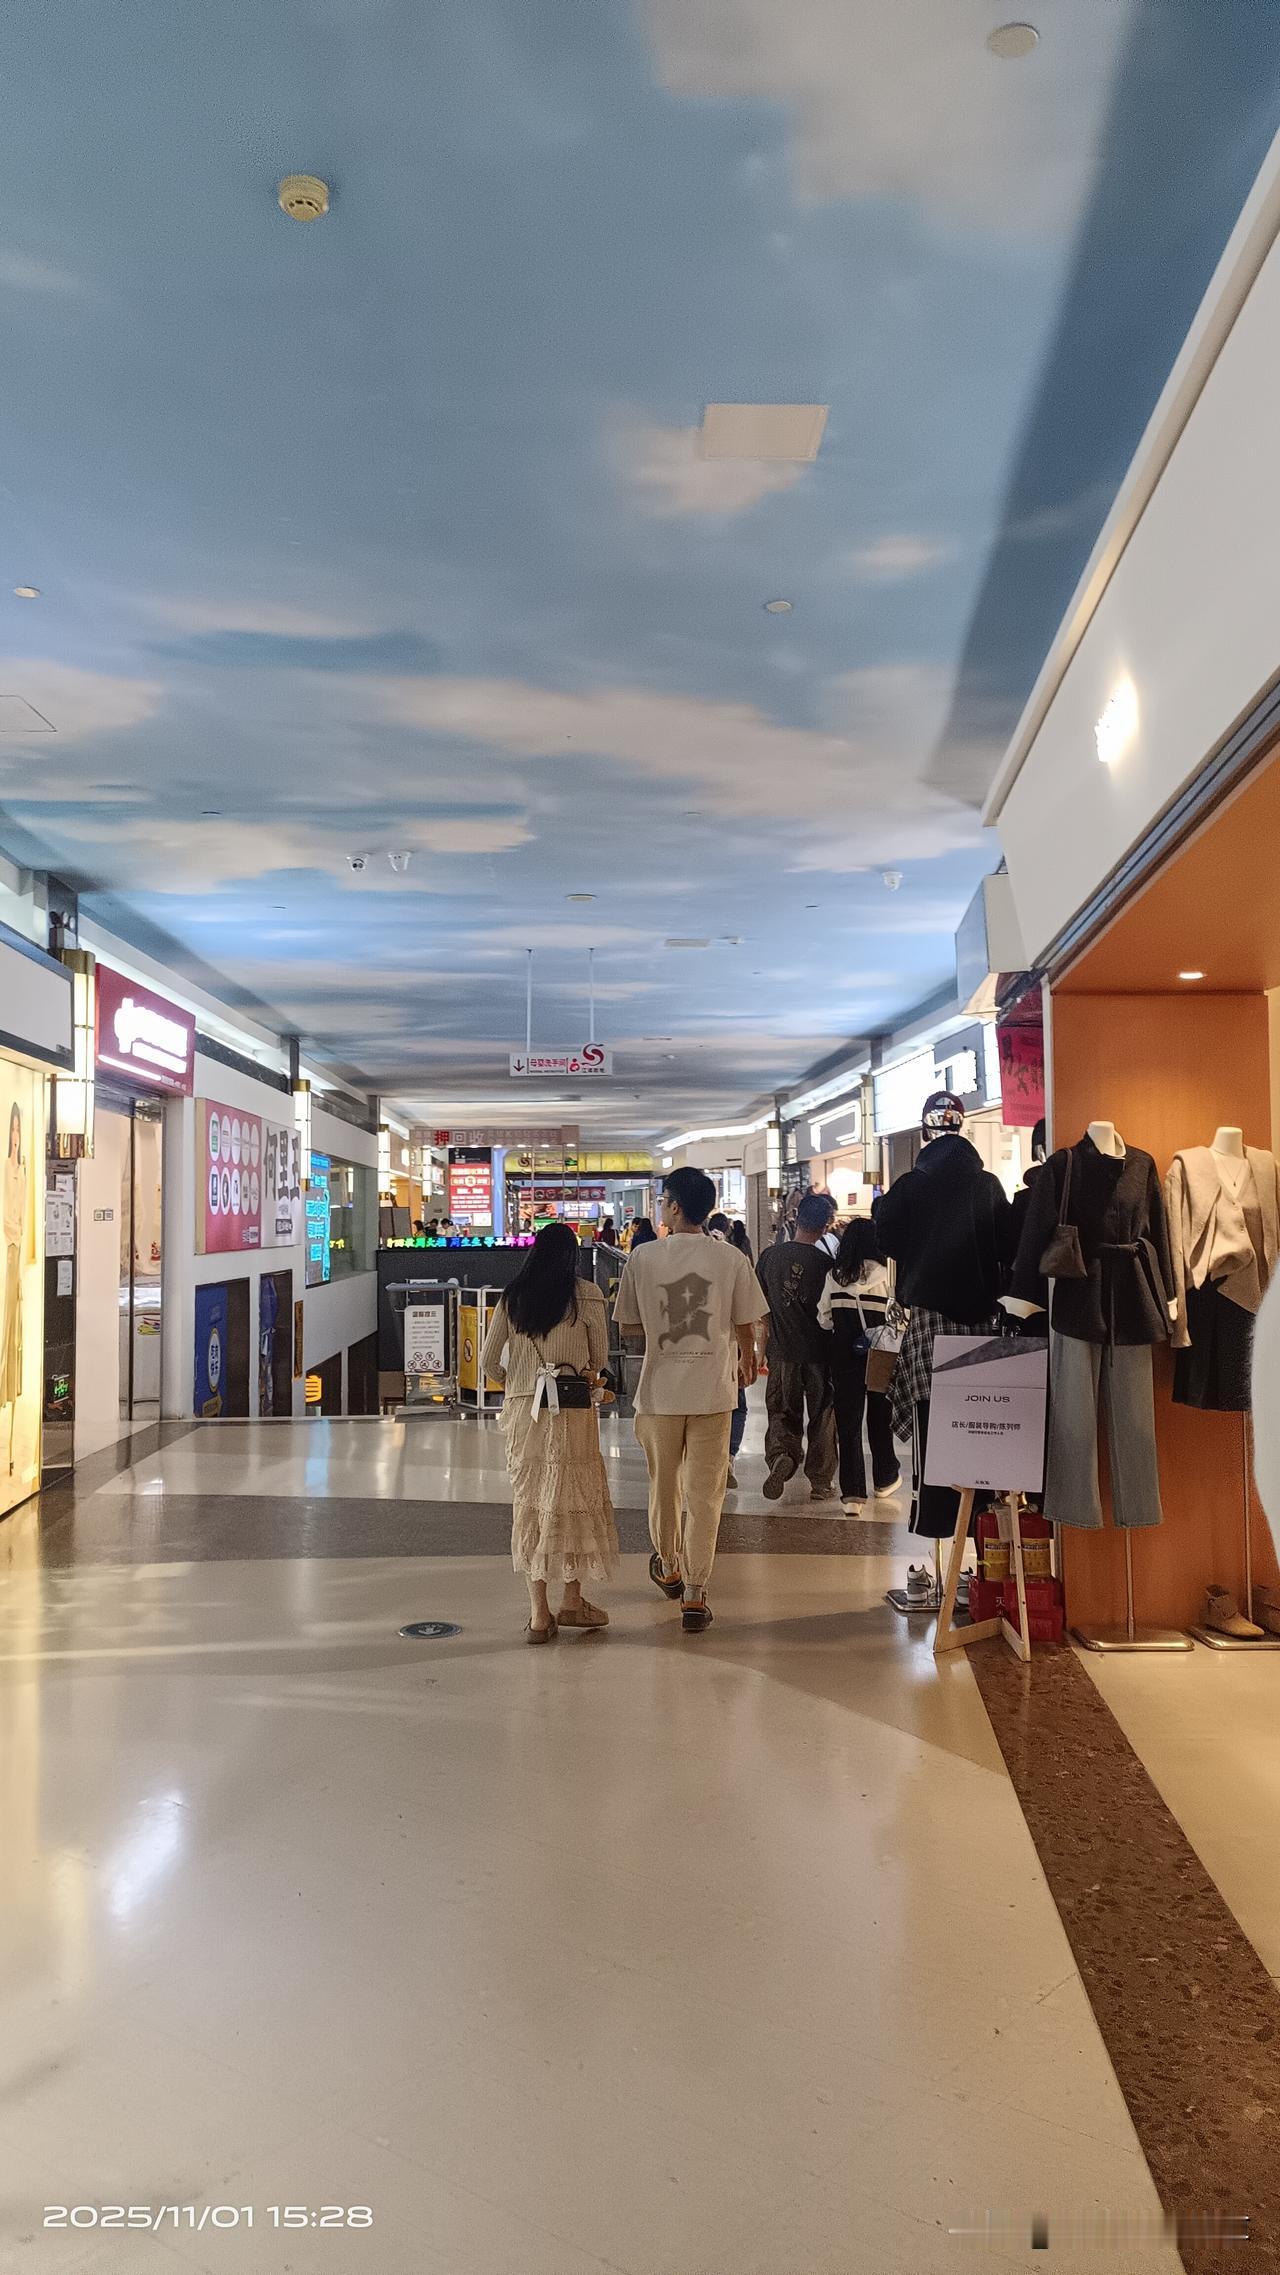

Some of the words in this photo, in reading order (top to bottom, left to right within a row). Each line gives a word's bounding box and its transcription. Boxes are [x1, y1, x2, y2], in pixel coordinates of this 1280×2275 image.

[965, 1395, 991, 1403] JOIN
[951, 1420, 1022, 1432] 店长/服装导购/陈列师
